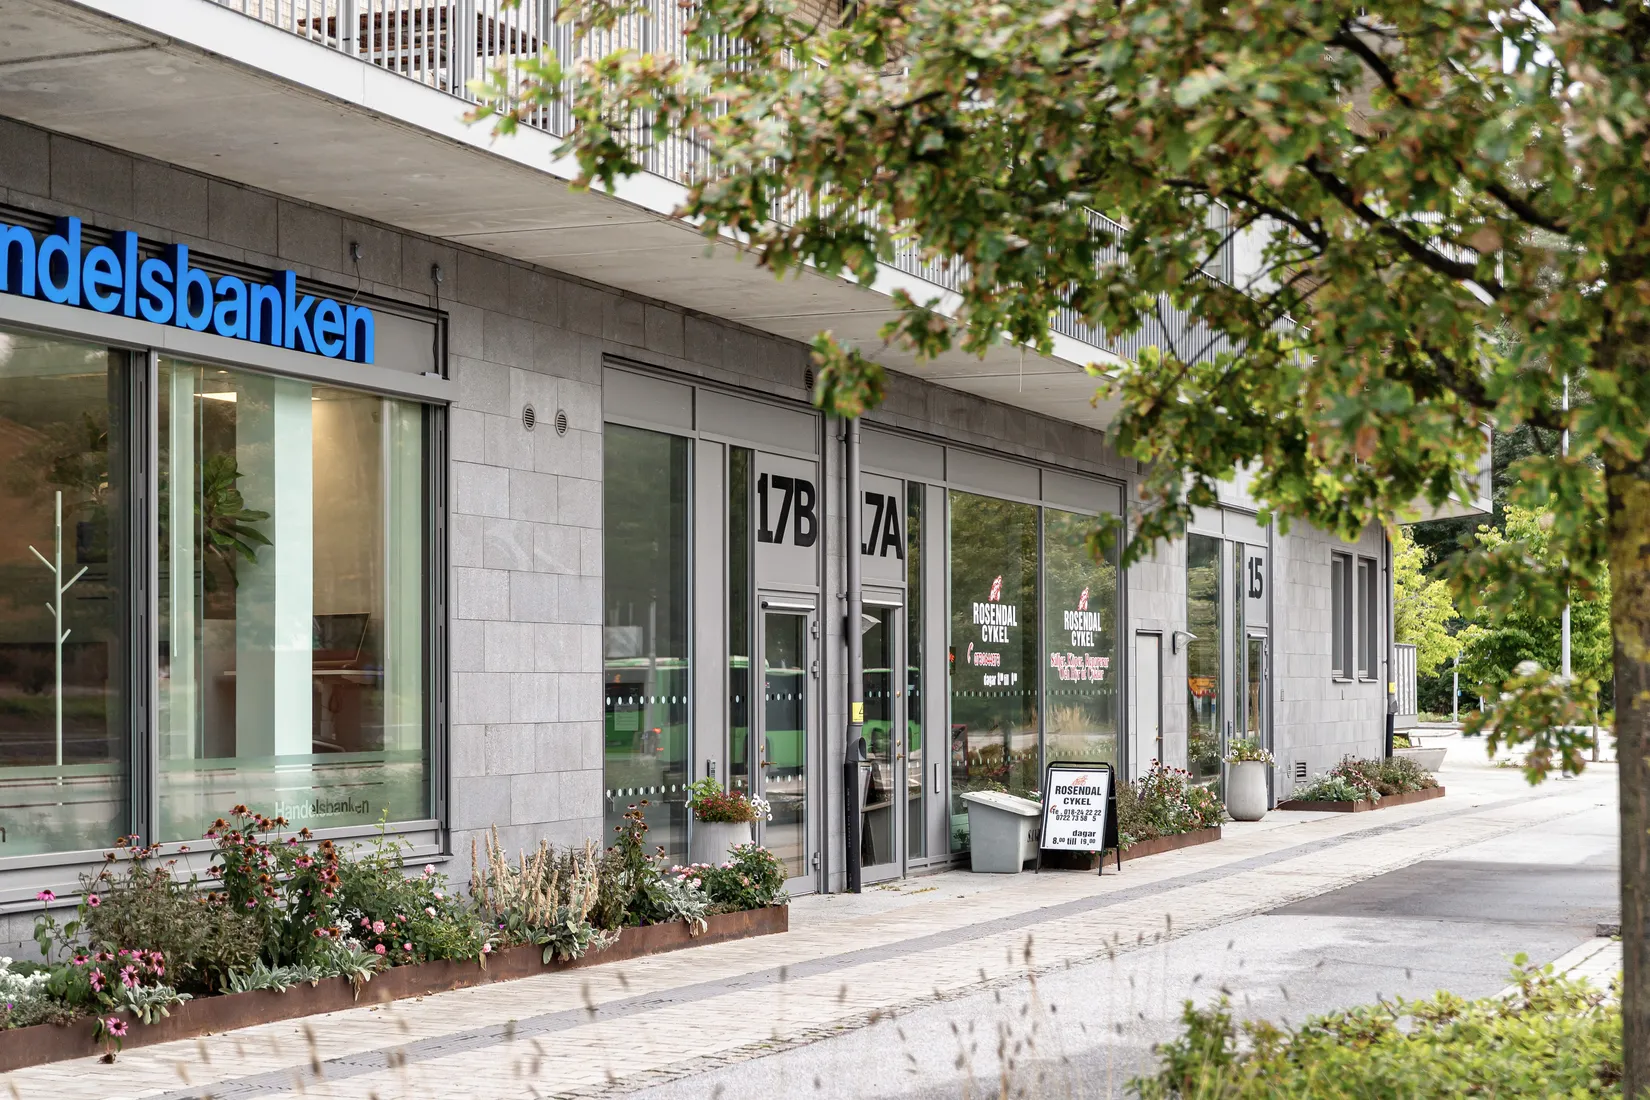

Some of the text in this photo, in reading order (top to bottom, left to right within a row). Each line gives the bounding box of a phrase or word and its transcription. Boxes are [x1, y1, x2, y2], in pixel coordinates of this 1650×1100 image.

[0, 216, 375, 364] ndelsbanken
[757, 472, 818, 548] 17B
[860, 490, 904, 560] 7A
[1248, 556, 1263, 599] 15
[973, 603, 1017, 626] ROSENDAL
[1064, 611, 1101, 631] ROSENDAL
[982, 625, 1009, 643] CYKEL
[1071, 631, 1095, 646] CYKEL
[1055, 786, 1102, 795] ROSENDAL
[274, 797, 370, 820] Handelsbanken
[1072, 830, 1097, 838] dagar
